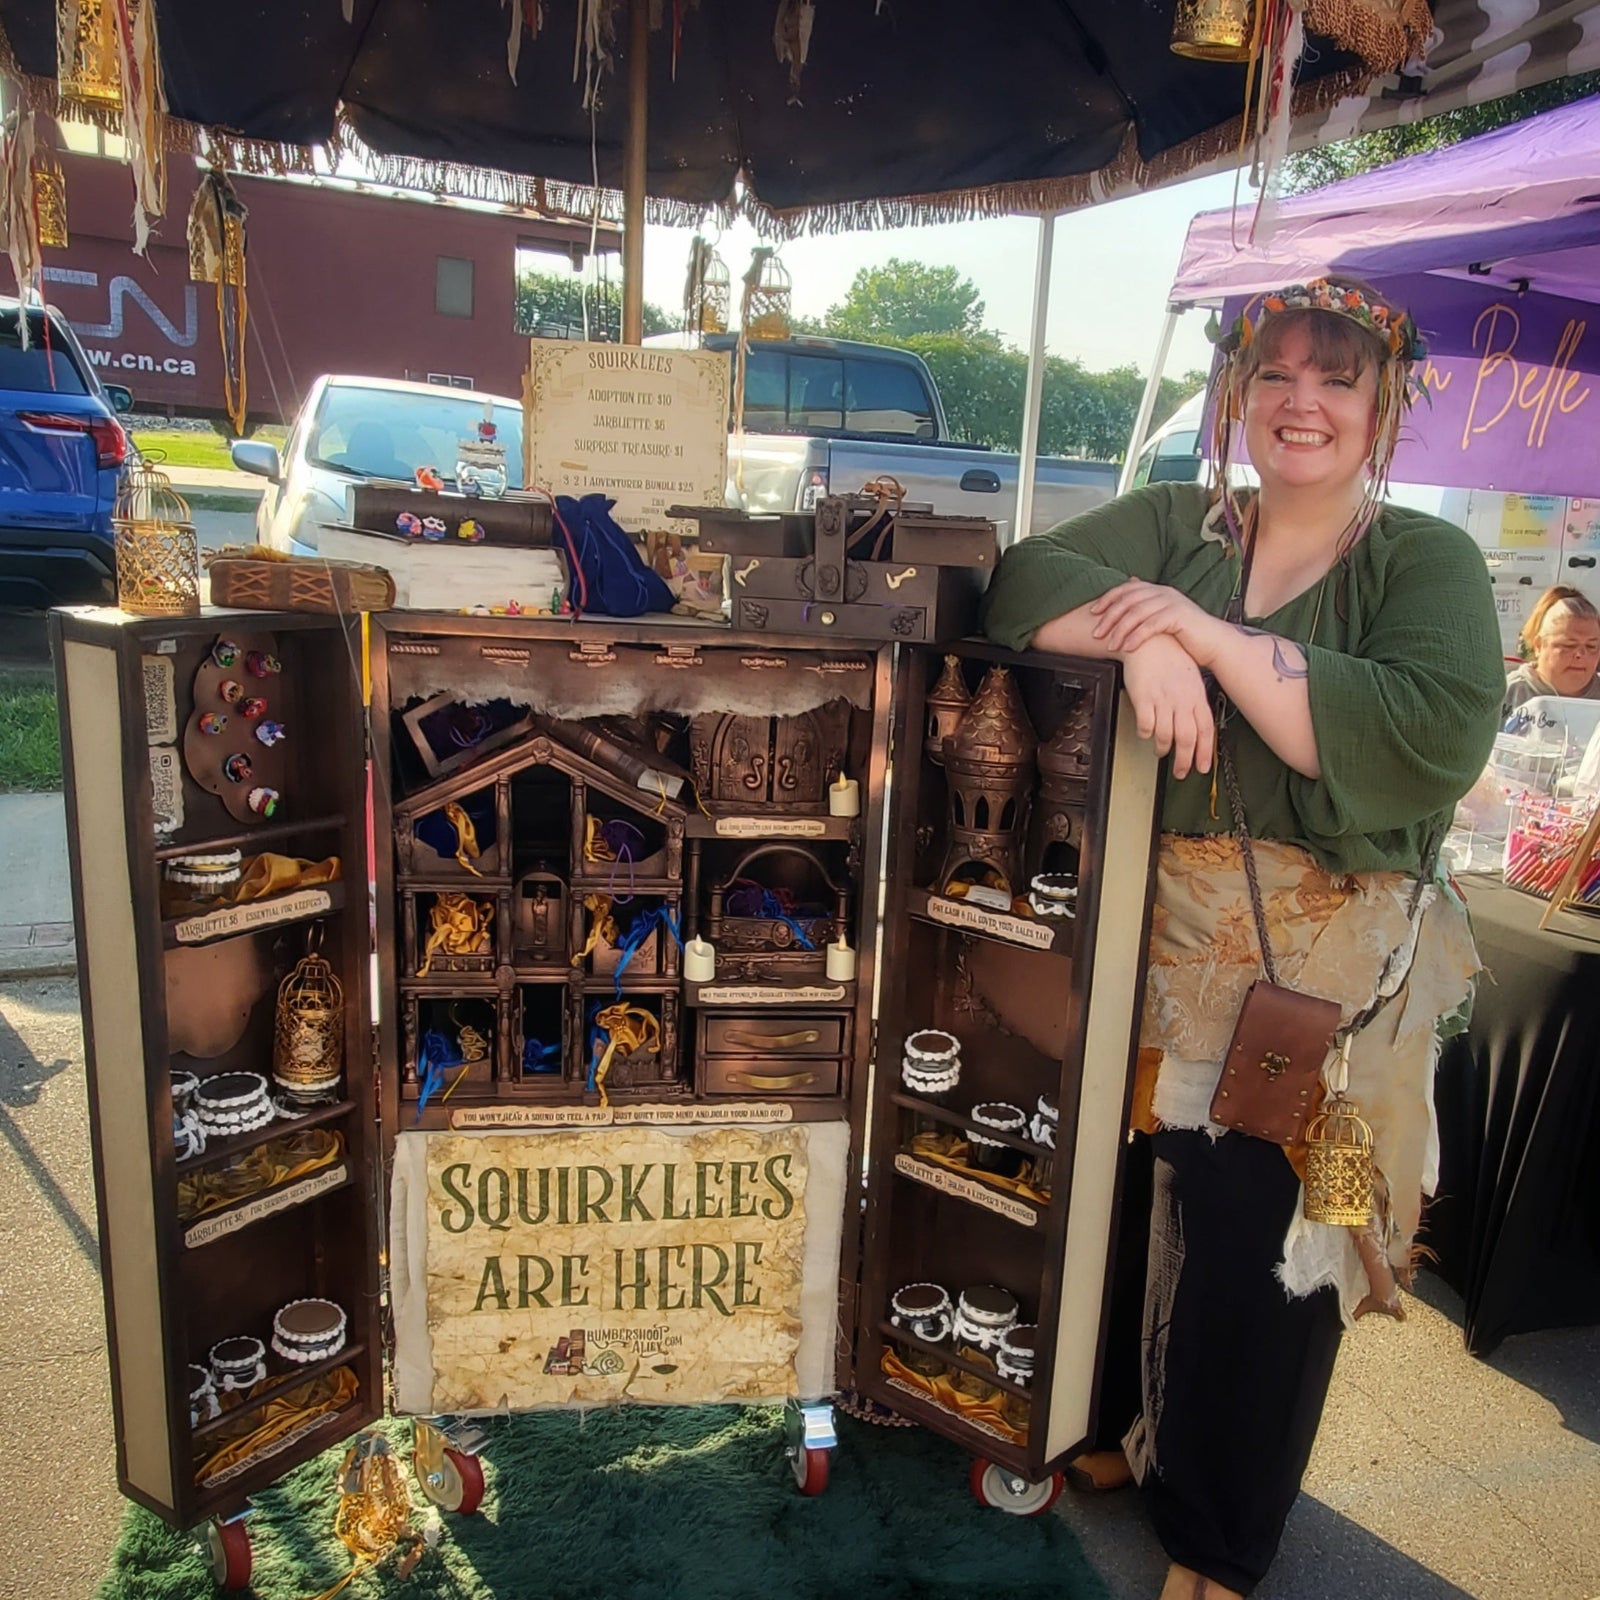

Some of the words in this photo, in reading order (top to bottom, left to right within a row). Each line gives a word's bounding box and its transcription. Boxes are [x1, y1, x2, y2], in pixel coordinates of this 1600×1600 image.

[86, 349, 197, 376] w.cn.ca
[588, 351, 674, 374] SQUIRKLEES
[1461, 302, 1591, 451] Belle
[588, 388, 635, 404] ADOPTION
[637, 390, 654, 406] FEE
[657, 391, 673, 407] $10
[574, 438, 620, 455] SURPRISE
[621, 441, 673, 458] TREASURE
[674, 444, 684, 458] $1
[589, 476, 643, 490] ADVENTURER
[644, 478, 677, 492] BUNDLE
[677, 481, 695, 494] $25
[245, 906, 279, 922] ESSENTIAL
[280, 903, 293, 915] FOR
[1015, 925, 1034, 938] SALES
[463, 1112, 477, 1122] YOU
[503, 1112, 523, 1122] HEAR
[524, 1112, 530, 1121] A
[531, 1112, 554, 1121] SOUND
[555, 1112, 565, 1121] OR
[566, 1112, 584, 1121] FEEL
[584, 1112, 590, 1121] A
[633, 1111, 654, 1121] QUIET
[656, 1111, 675, 1120] YOUR
[675, 1111, 693, 1120] MIND
[695, 1111, 710, 1119] AND
[730, 1110, 748, 1118] YOUR
[750, 1109, 769, 1118] HAND
[439, 1153, 796, 1234] SQUIRKLEES
[250, 1204, 263, 1216] FOR
[473, 1253, 591, 1313] ARE
[612, 1242, 764, 1317] HERE
[586, 1323, 670, 1350] BUMBERSHOOT
